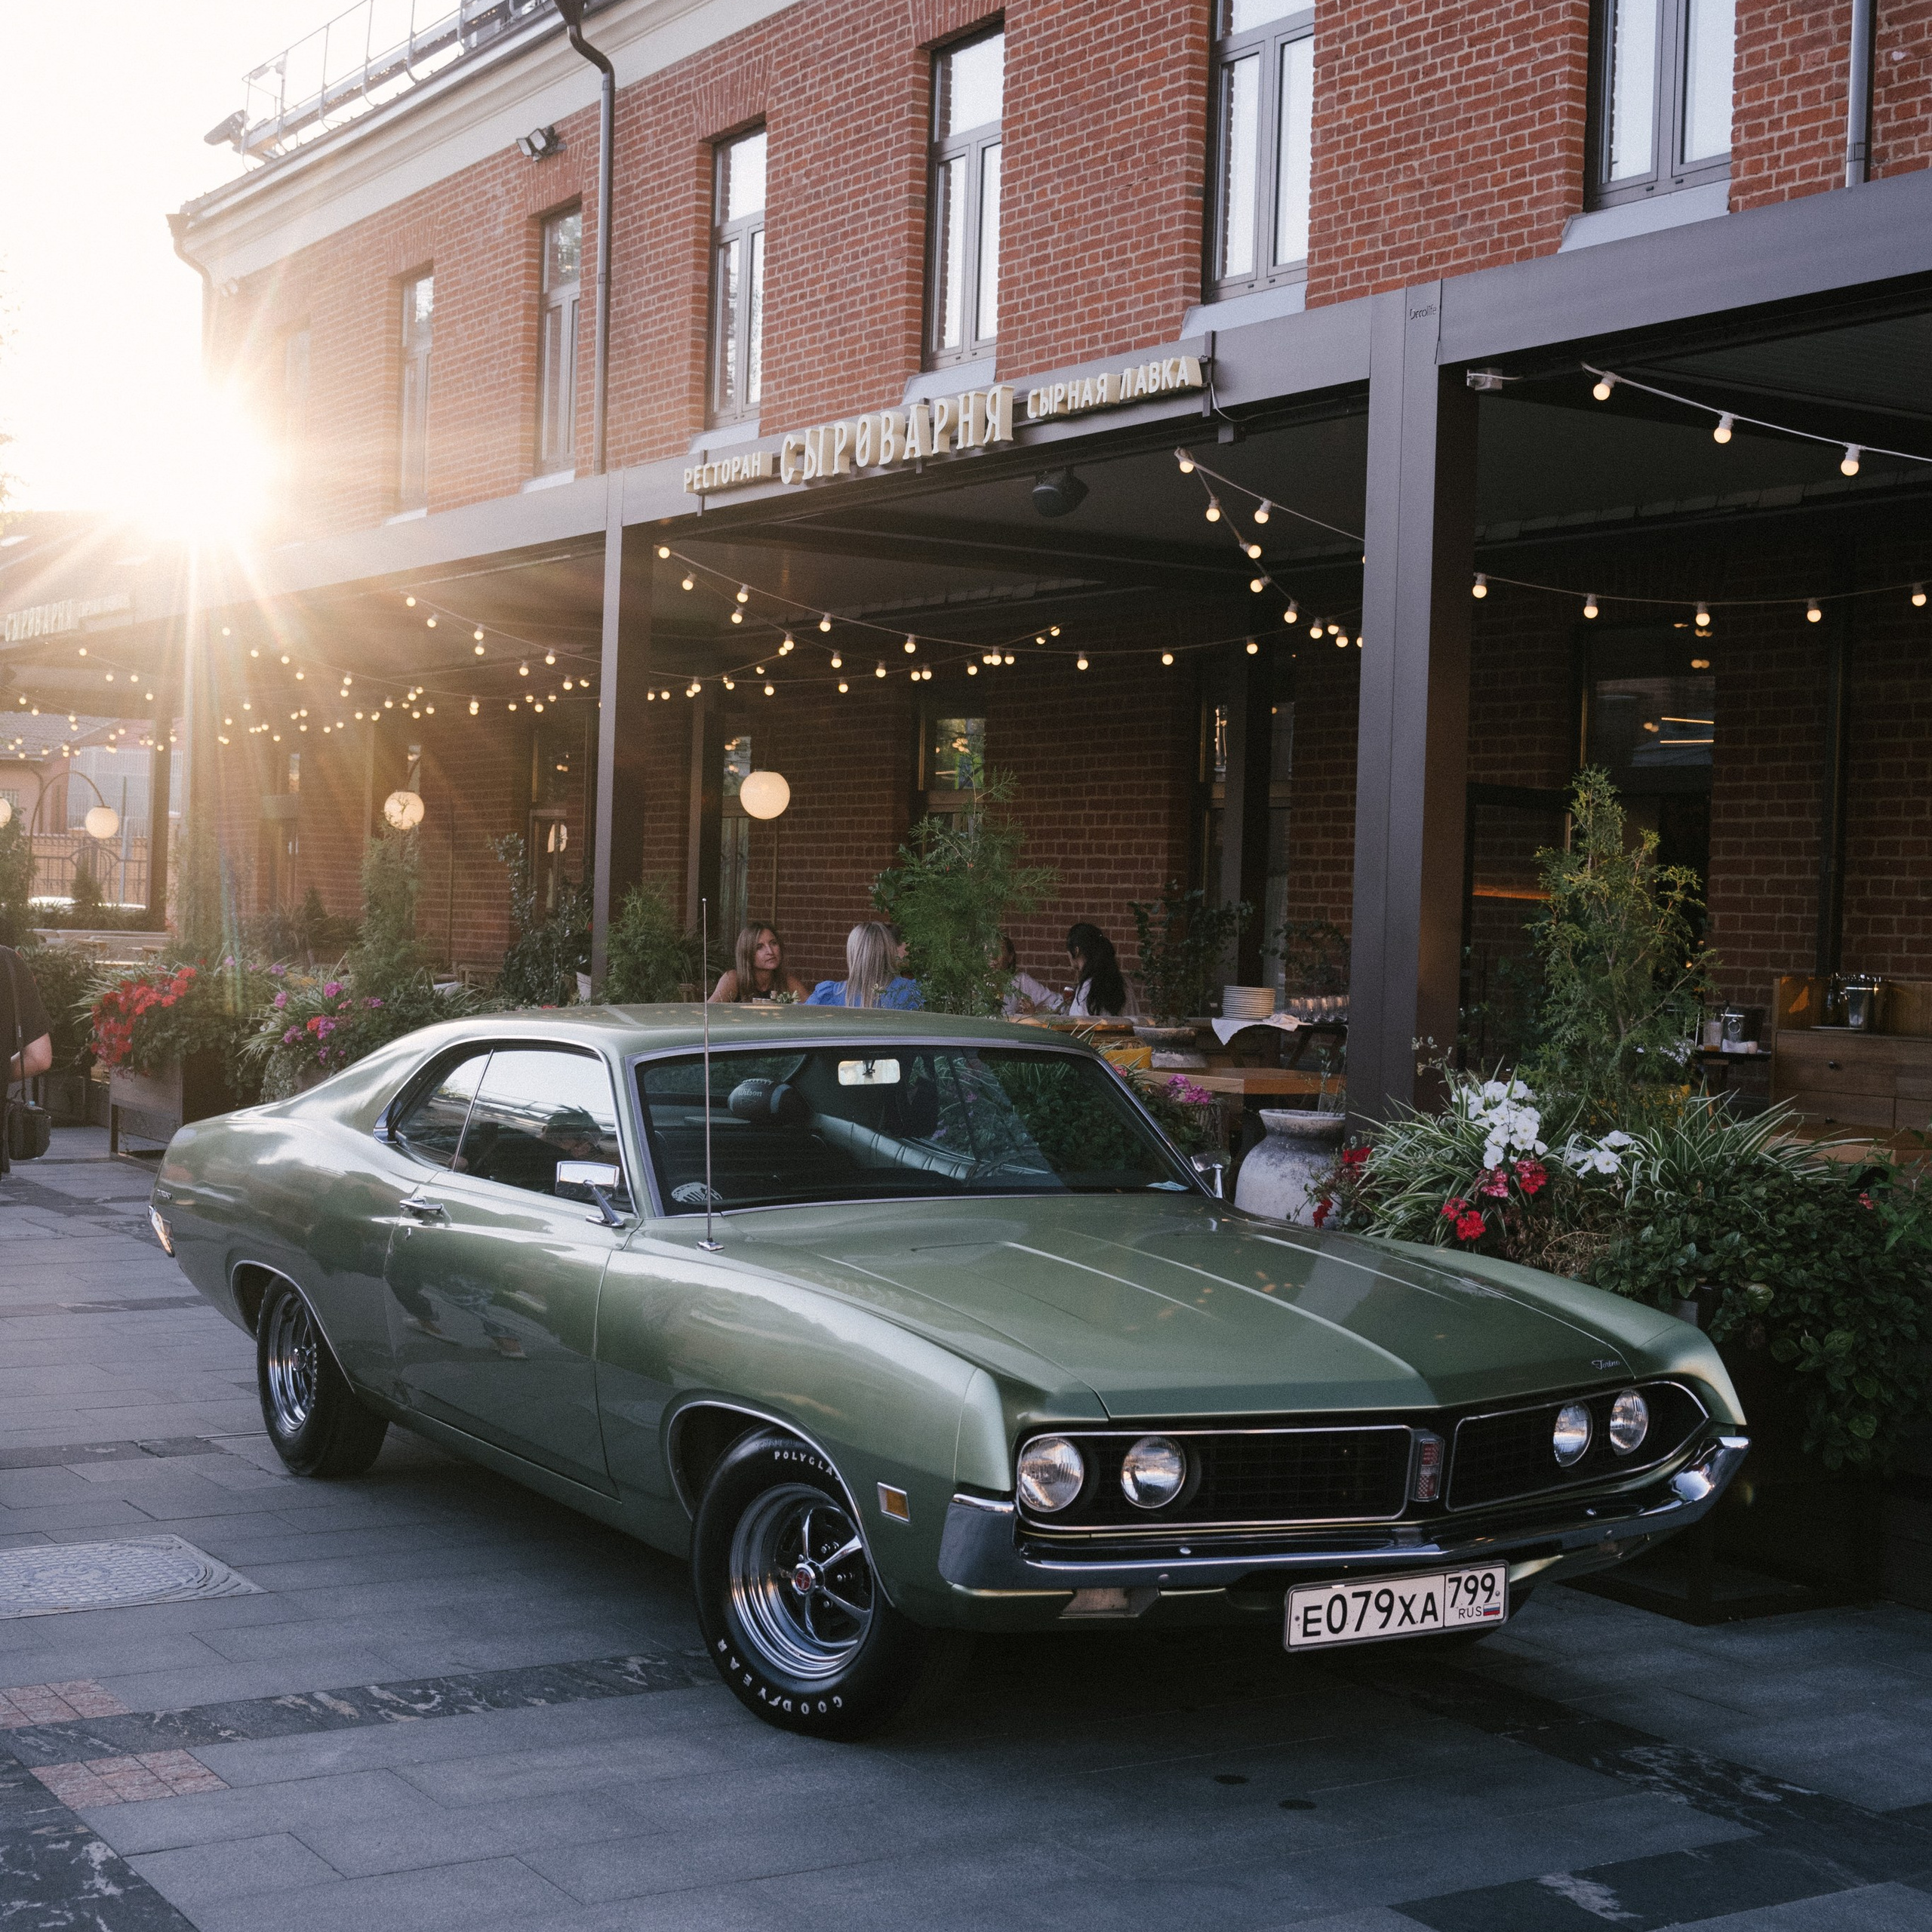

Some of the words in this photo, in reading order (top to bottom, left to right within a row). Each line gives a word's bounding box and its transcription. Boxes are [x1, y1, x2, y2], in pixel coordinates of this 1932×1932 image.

[1027, 373, 1118, 419] СЫРНАЯ
[1120, 355, 1200, 401] ЛАВКА
[683, 451, 767, 493] РЕСТОРАН
[780, 385, 1014, 485] СЫРОВАРНЯ
[738, 1088, 762, 1097] Wilson
[1592, 1359, 1620, 1370] Torino
[1448, 1572, 1496, 1608] 799
[1458, 1605, 1482, 1620] RUS
